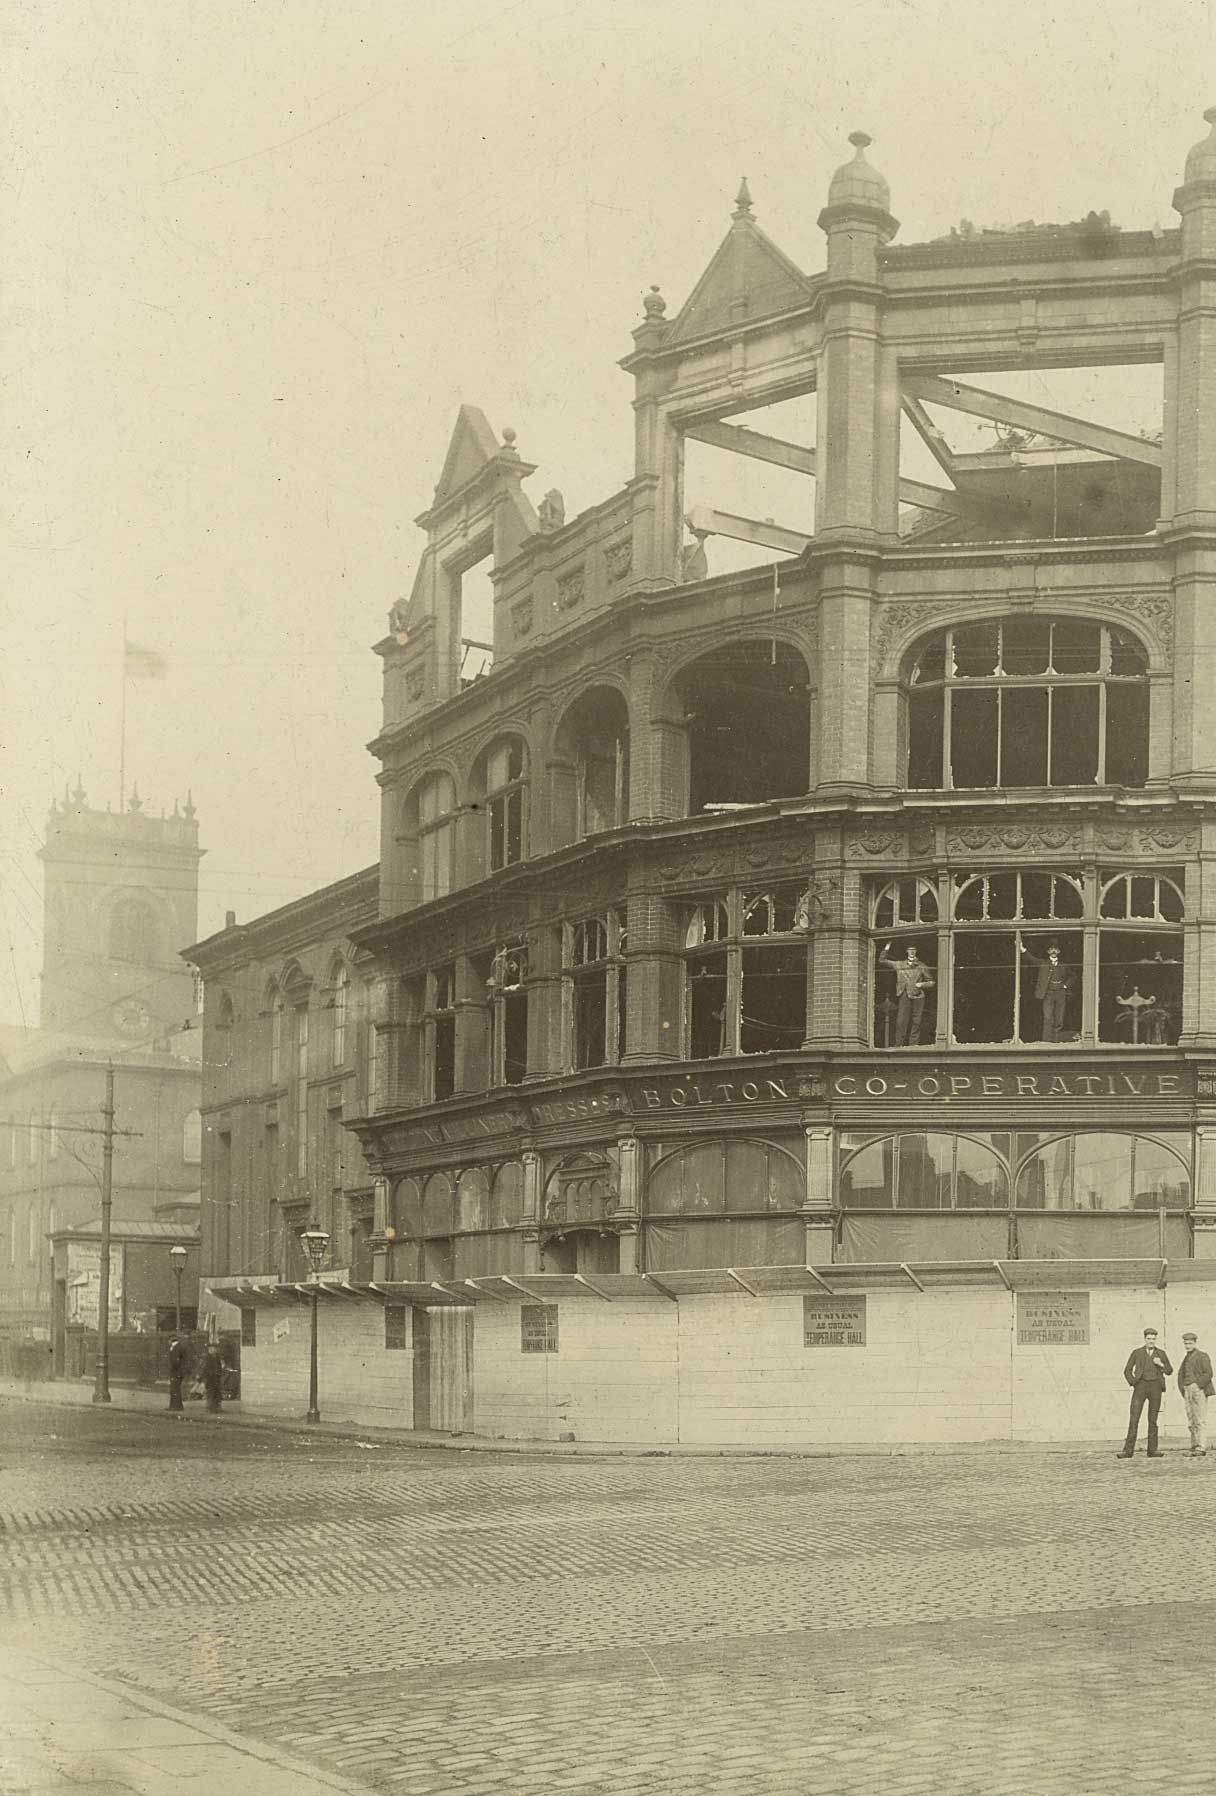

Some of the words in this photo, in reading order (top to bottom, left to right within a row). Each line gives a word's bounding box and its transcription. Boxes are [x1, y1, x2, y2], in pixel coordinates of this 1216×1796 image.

[642, 1078, 790, 1108] BOLTON
[834, 1074, 1181, 1098] CO-OPERATIVE
[811, 1312, 859, 1320] BUSINESS
[1025, 1310, 1081, 1318] BUSINESS
[1031, 1319, 1043, 1327] AS
[1046, 1319, 1075, 1327] USUAL
[806, 1331, 845, 1345] TEMPERANCE
[847, 1331, 864, 1345] HALL
